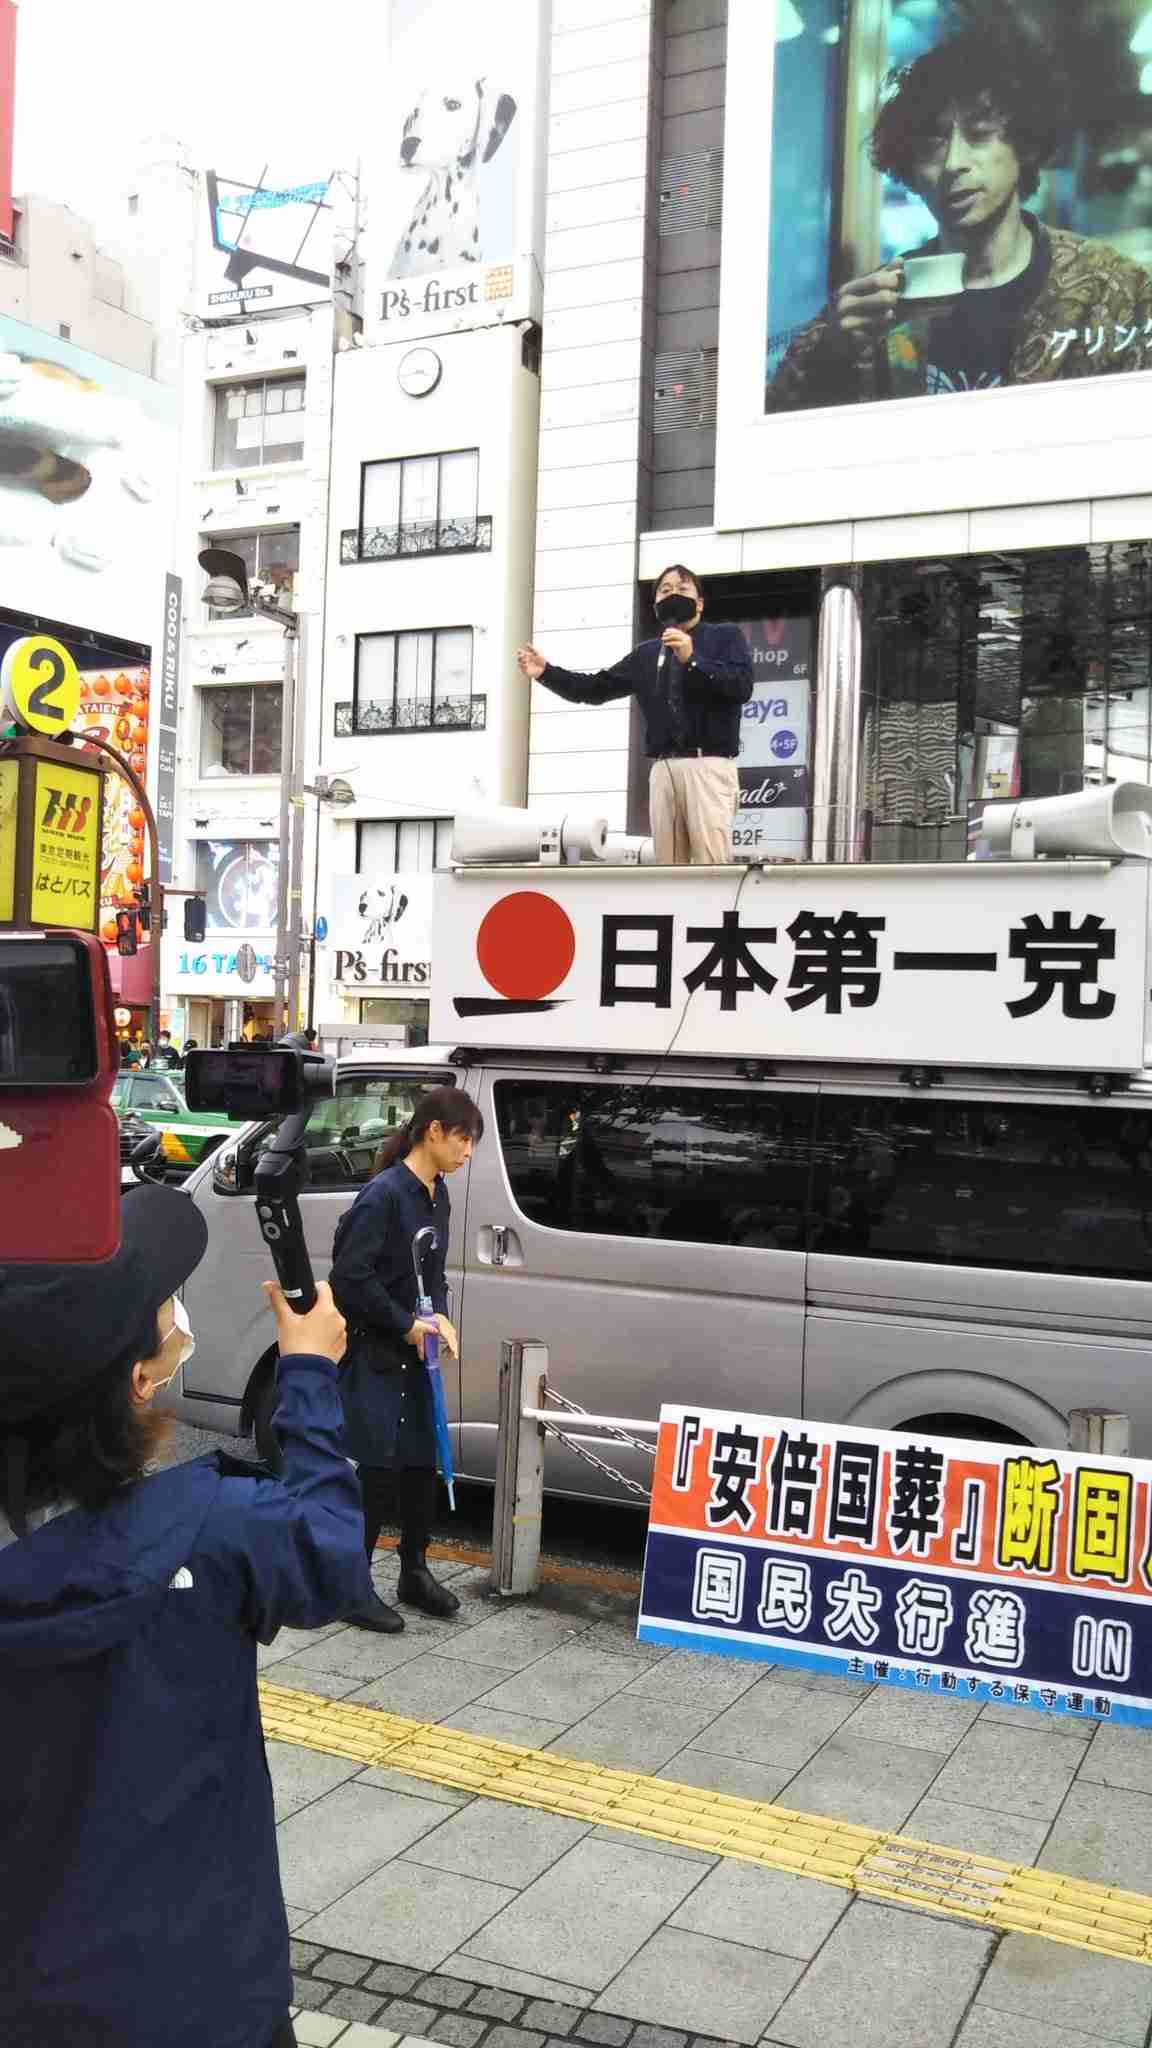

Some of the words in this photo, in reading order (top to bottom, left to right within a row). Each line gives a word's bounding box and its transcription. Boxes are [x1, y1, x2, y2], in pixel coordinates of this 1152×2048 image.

[752, 648, 789, 667] hop
[28, 648, 65, 721] 2
[743, 698, 788, 724] aya
[739, 778, 783, 805] ade
[732, 829, 763, 846] B2F
[36, 872, 91, 899] はとバス
[178, 951, 207, 975] 16
[600, 910, 1116, 1019] 日本第一党
[676, 1415, 1152, 1585] 『安倍国葬』断固
[696, 1551, 1023, 1665] 国民大行進
[1075, 1617, 1129, 1680] IN
